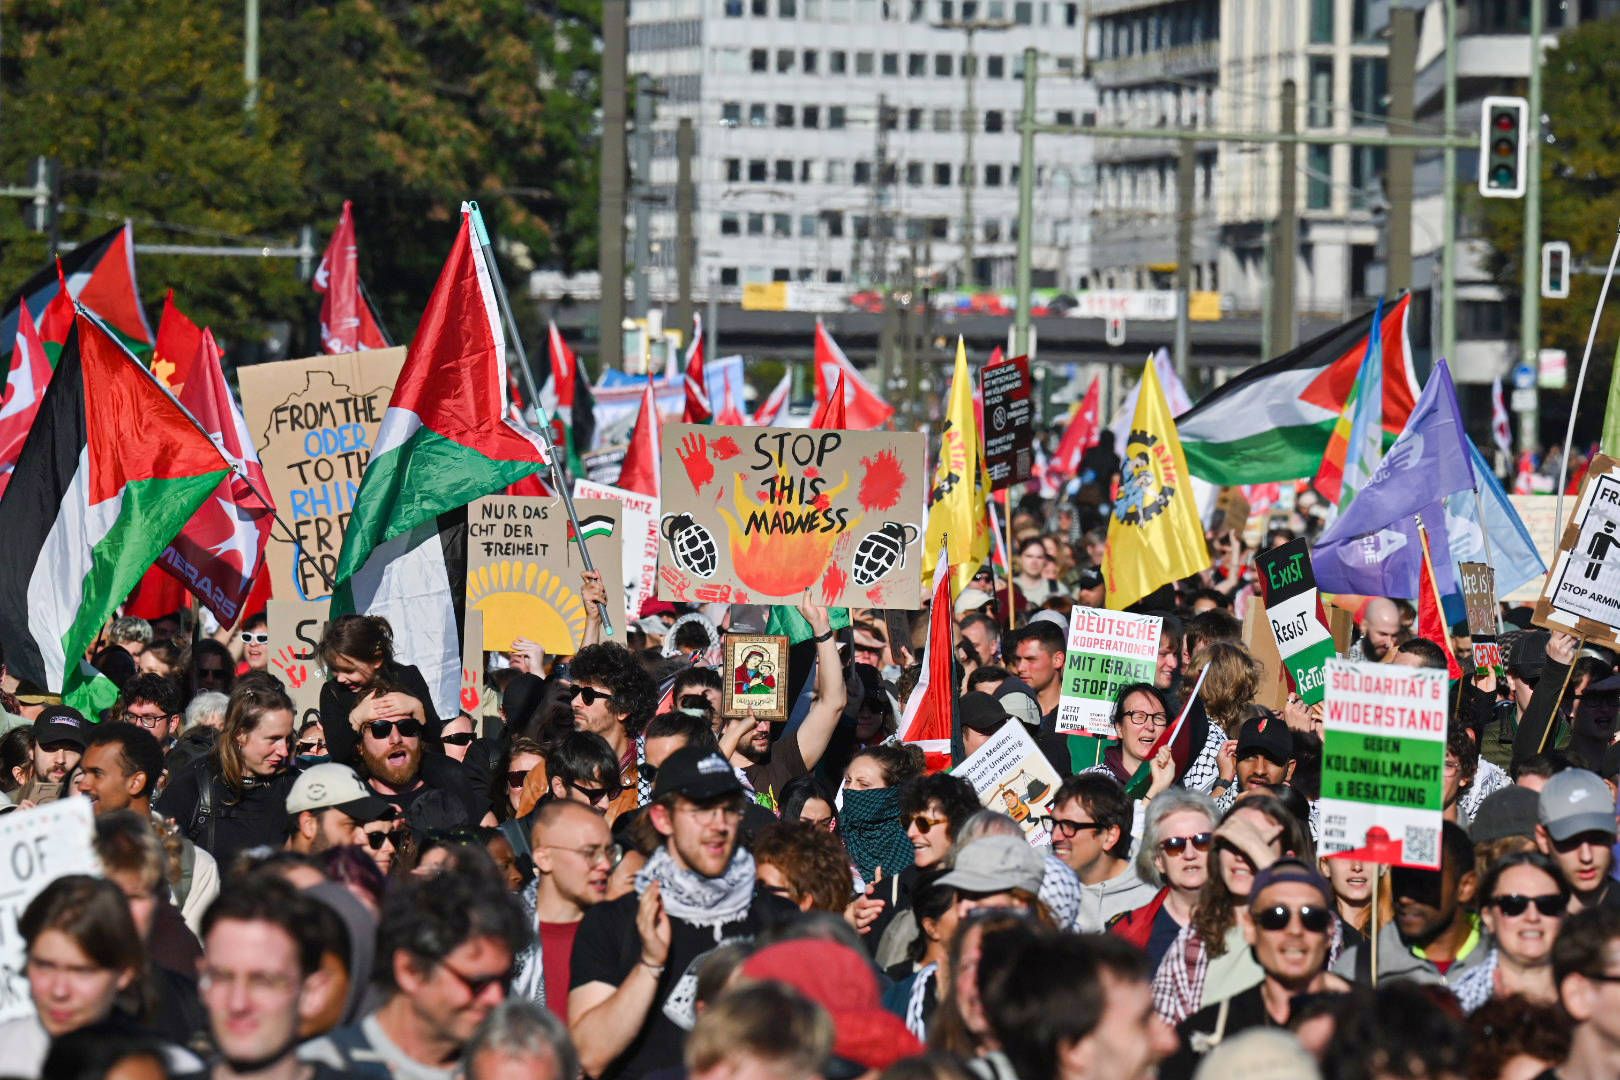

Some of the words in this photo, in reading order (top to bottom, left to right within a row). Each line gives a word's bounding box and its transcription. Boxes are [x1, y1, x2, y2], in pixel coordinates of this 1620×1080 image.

[274, 401, 337, 434] FROM
[335, 395, 381, 423] THE
[304, 423, 370, 457] ODER
[751, 431, 842, 470] STOP
[287, 458, 334, 485] TO
[337, 450, 372, 478] TH
[761, 476, 827, 505] THIS
[1600, 487, 1620, 507] FR
[482, 503, 518, 520] NUR
[523, 505, 549, 520] DAS
[745, 508, 849, 536] MADNESS
[295, 512, 352, 554] FR
[469, 523, 497, 537] CHT
[503, 523, 533, 538] DER
[481, 541, 549, 557] FREIHEIT
[1561, 582, 1588, 598] STOP
[1588, 591, 1620, 610] ARMIN
[1075, 614, 1157, 641] DEUTSCHE
[1072, 635, 1155, 656] KOOPERATIONEN
[1069, 654, 1095, 673] MIT
[1101, 658, 1150, 680] ISRAEL
[1072, 677, 1127, 697] STOPP
[1061, 714, 1079, 722] AKTIV
[1062, 704, 1080, 714] JETZT
[1328, 700, 1444, 732] WIDERSTAND
[1060, 722, 1085, 732] WERDEN
[964, 756, 987, 778] utsche
[985, 733, 1013, 758] Medien:
[1363, 735, 1402, 754] GEGEN
[973, 766, 989, 784] heit?
[1325, 753, 1440, 783] KOLONIALMACHT
[978, 772, 999, 793] lance?
[1347, 780, 1426, 806] BESATZUNG
[11, 836, 49, 881] OF
